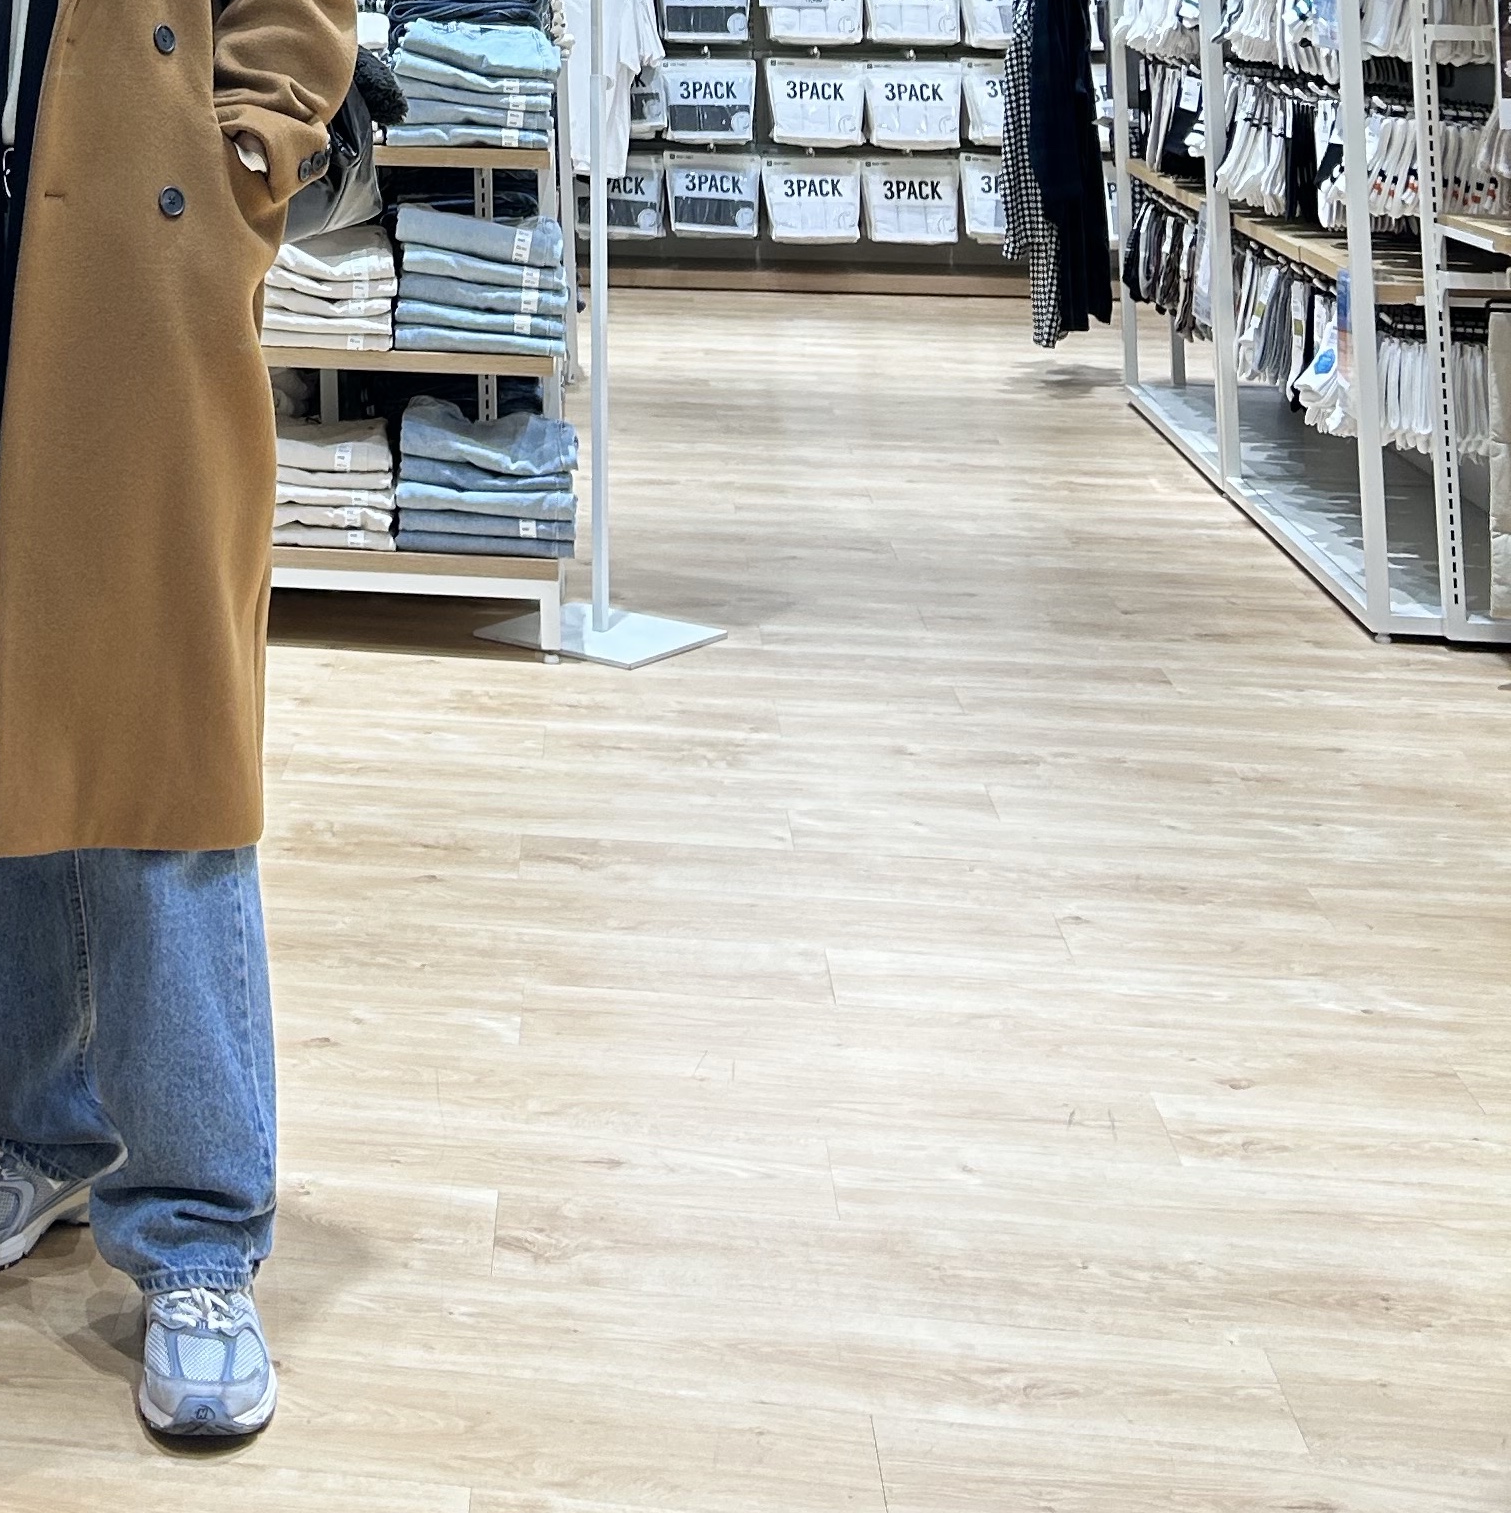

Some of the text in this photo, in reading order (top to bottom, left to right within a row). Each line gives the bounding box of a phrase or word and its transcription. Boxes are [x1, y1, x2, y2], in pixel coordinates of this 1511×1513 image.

[679, 81, 737, 99] 3PACK
[786, 80, 844, 100] 3PACK
[884, 82, 943, 101] 3PACK
[685, 172, 742, 194] 3PACK
[784, 177, 842, 198] 3PACK
[883, 180, 941, 200] 3PACK
